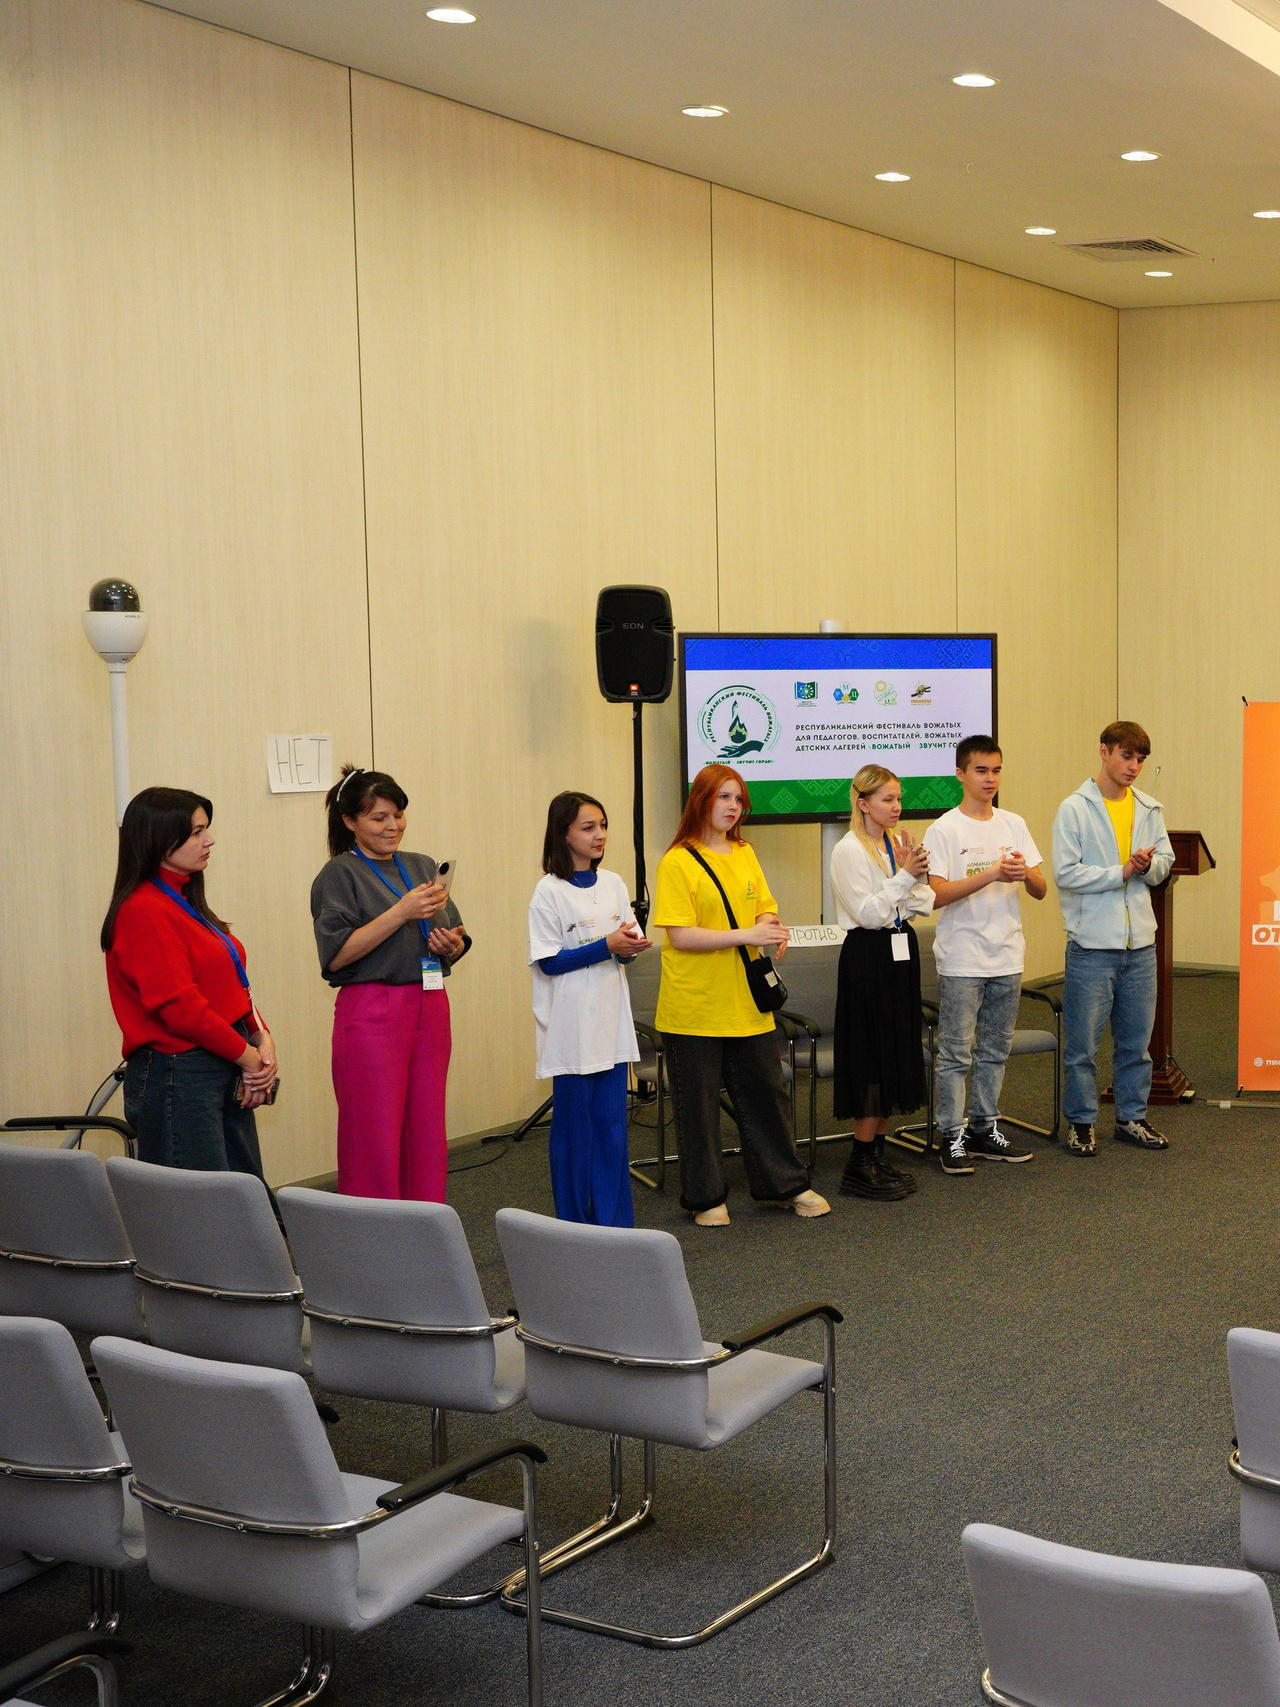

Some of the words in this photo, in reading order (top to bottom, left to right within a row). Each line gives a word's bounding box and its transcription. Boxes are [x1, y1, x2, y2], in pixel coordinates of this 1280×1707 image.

[622, 622, 644, 630] EON
[795, 722, 874, 731] РЕСПУБЛИКАНСКИЙ
[795, 744, 831, 752] ДЕТСКИХ
[832, 742, 866, 751] ЛАГЕРЕЙ
[275, 737, 328, 785] НЕТ
